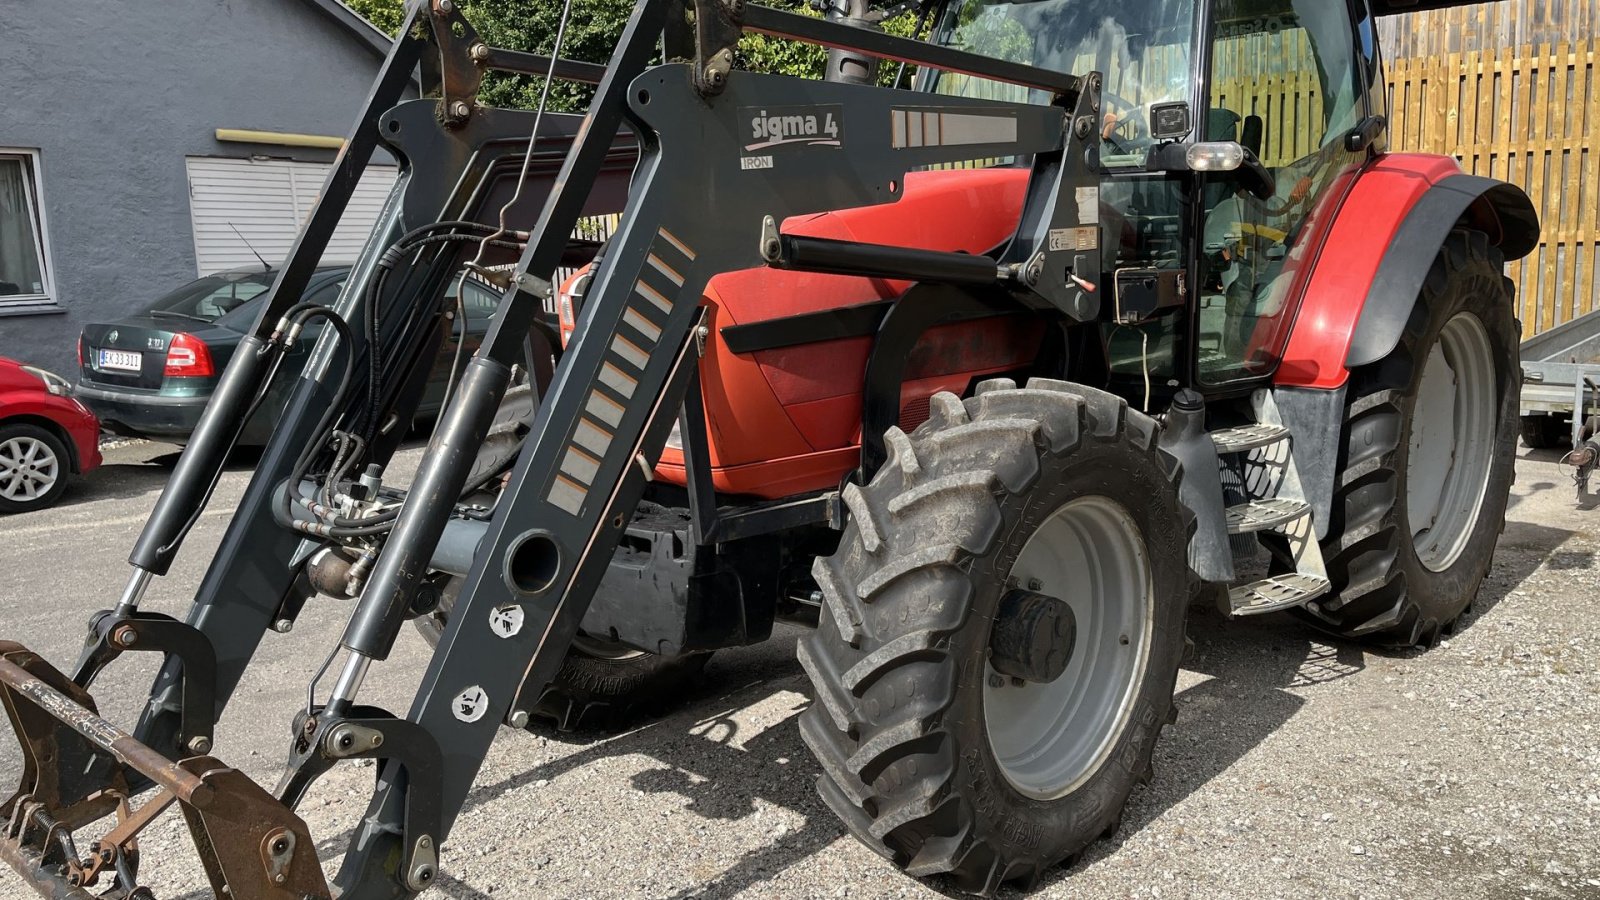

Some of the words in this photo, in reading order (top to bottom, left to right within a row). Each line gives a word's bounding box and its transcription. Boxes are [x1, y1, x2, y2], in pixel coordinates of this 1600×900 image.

[752, 110, 818, 143] sigma
[824, 113, 839, 138] 4
[743, 157, 769, 169] IRON
[115, 353, 124, 365] 33
